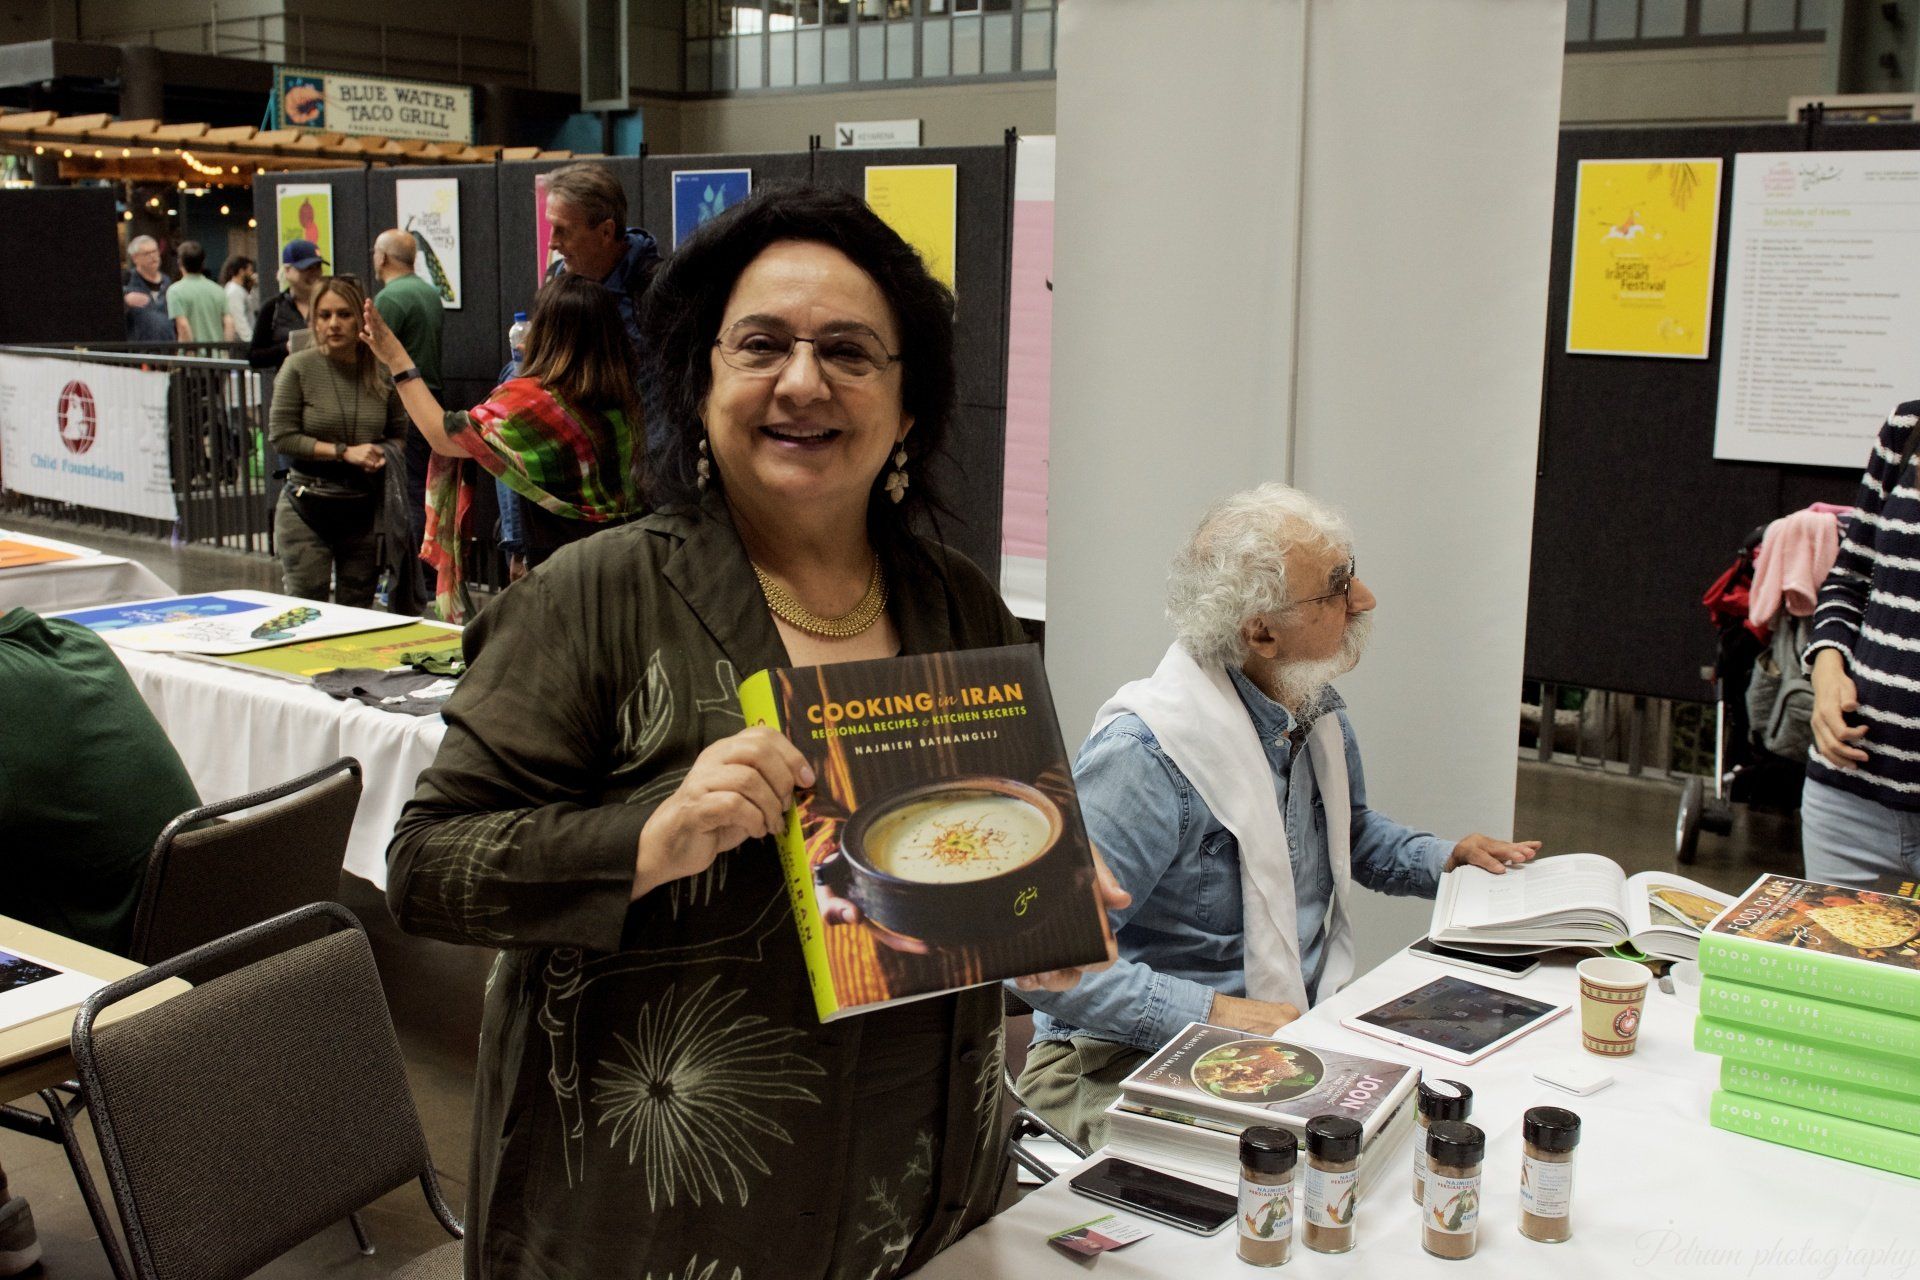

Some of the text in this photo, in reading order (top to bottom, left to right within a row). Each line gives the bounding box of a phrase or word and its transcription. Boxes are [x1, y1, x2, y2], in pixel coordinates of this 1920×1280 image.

[339, 85, 456, 112] BLUE WATER
[348, 105, 450, 129] TACO GRILL
[1605, 267, 1649, 280] Iranian
[1620, 279, 1666, 292] Festival
[30, 453, 125, 482] Child Foundation
[807, 683, 1024, 724] COOKING in IRAN
[811, 725, 872, 740] REGIONAL
[874, 718, 919, 733] RECIPES
[932, 711, 980, 726] KITCHEN
[983, 705, 1028, 719] SECRETS
[854, 730, 998, 756] NAJMIEH BATMANGLIJ
[793, 877, 813, 941] IRAN
[1727, 879, 1794, 931] FOOD OF LIFE
[1708, 946, 1819, 975] FOOD OF LIFE
[1707, 959, 1785, 981] NAJMIEH
[1799, 977, 1915, 1007] BATMANGLIJ
[1709, 988, 1820, 1018] FOOD OF LIFE
[1181, 1029, 1210, 1050] NAJMIEH
[1708, 1001, 1786, 1023] NAJMIEH
[1800, 1019, 1916, 1049] BATMANGLIJ
[1704, 1027, 1815, 1056] FOOD OF LIFE
[1145, 1050, 1185, 1081] BATMANGLIJ
[1704, 1040, 1910, 1087] NAJMIEH BATMANGLIJ
[1340, 1074, 1383, 1110] JOON
[1729, 1077, 1805, 1100] NAJMIEH
[1730, 1065, 1839, 1096] FOOD OF LIFE
[1720, 1116, 1795, 1140] NAJMIEH
[1721, 1103, 1829, 1137] FOOD OF LIFE
[1249, 1189, 1272, 1197] PERSIAN
